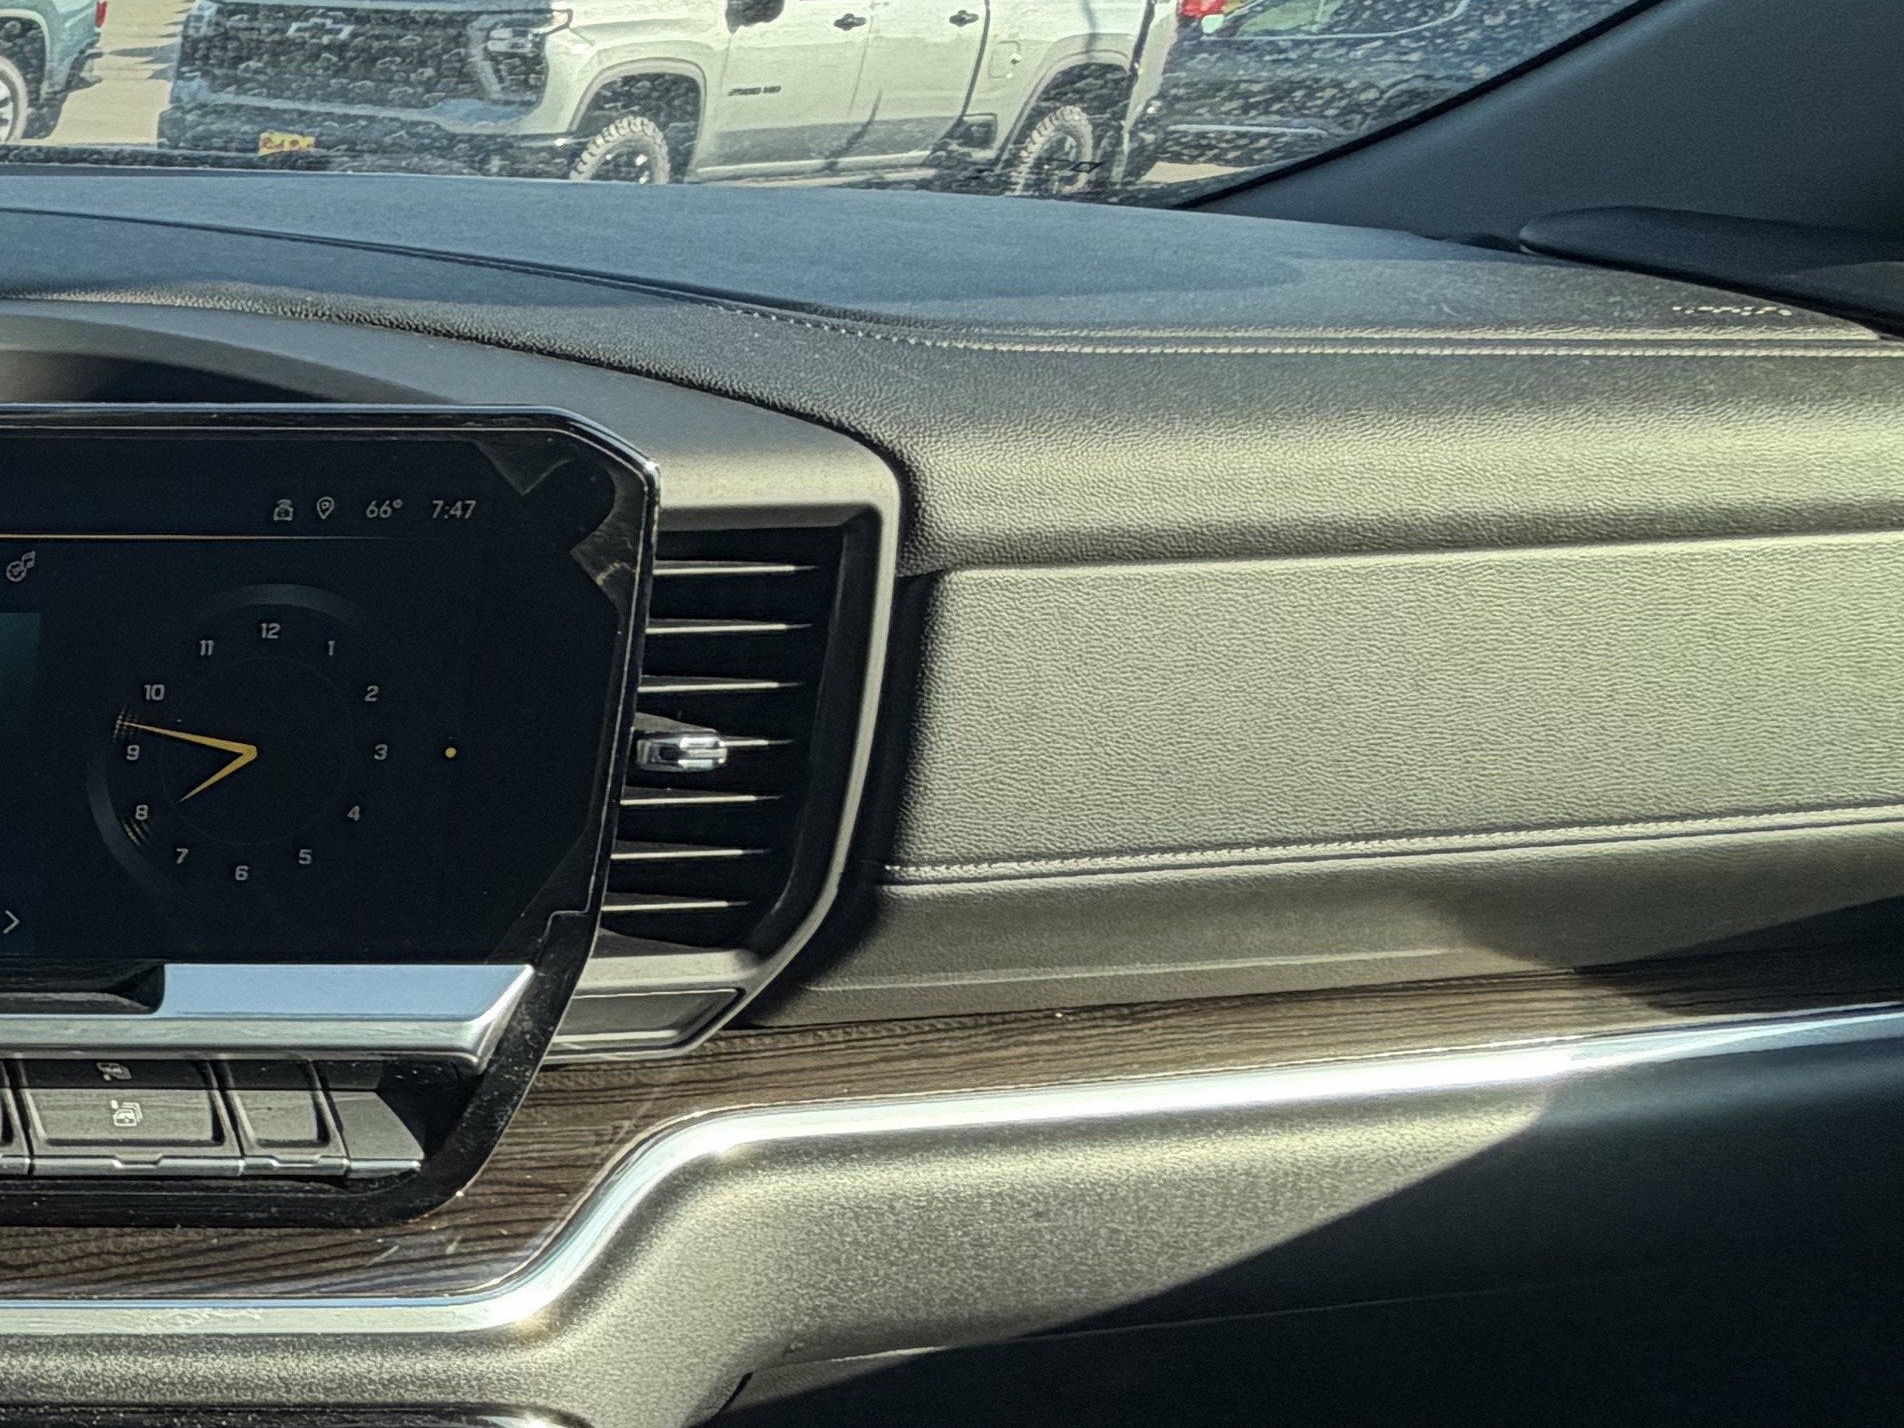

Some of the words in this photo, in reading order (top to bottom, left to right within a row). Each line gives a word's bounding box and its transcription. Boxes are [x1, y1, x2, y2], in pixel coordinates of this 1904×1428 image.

[366, 499, 402, 518] 66°
[433, 500, 476, 518] 7:47
[262, 623, 280, 638] 12
[201, 640, 214, 655] 11
[328, 641, 334, 656] 1
[145, 685, 164, 700] 10
[365, 686, 378, 701] 2
[127, 745, 139, 760] 9
[374, 744, 387, 760] 3
[135, 805, 148, 820] 8
[348, 806, 360, 821] 4
[177, 848, 188, 864] 7
[299, 849, 311, 864] 5
[235, 866, 248, 880] 6
